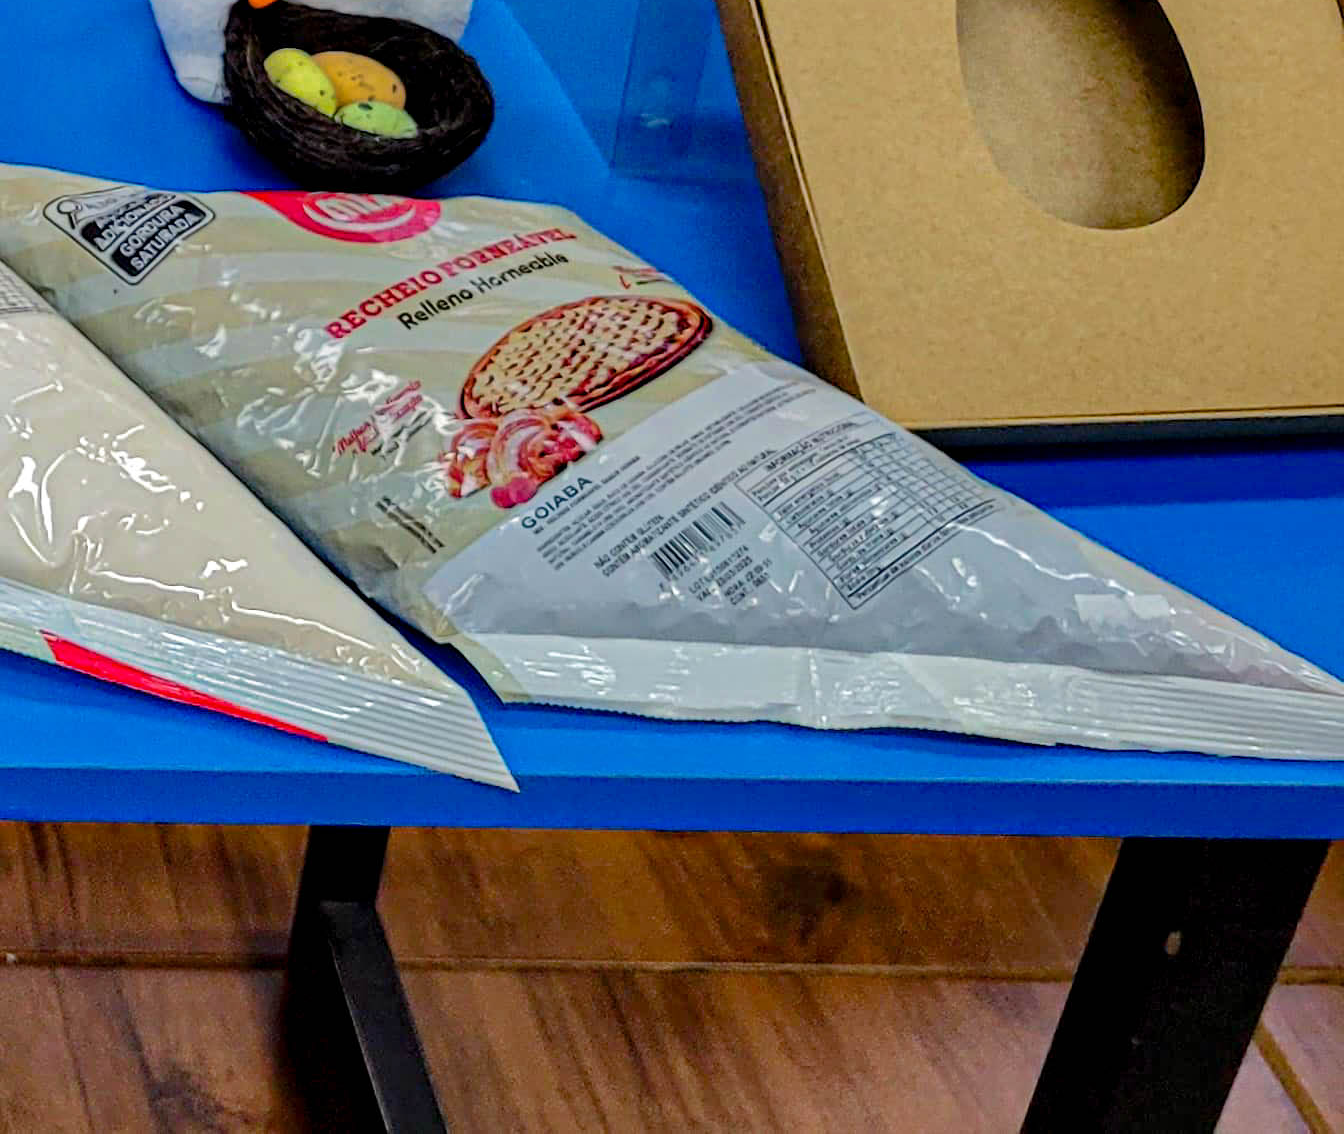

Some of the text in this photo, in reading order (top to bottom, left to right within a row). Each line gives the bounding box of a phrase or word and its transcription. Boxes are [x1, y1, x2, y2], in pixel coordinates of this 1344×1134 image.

[119, 204, 187, 257] GORDURA
[130, 212, 202, 271] SATURADA
[324, 227, 577, 339] RECHEIO FORNEÁVEL
[397, 289, 474, 331] Relleno
[471, 251, 569, 294] Horneable
[521, 477, 593, 529] GOIABA
[594, 554, 611, 569] NÃO
